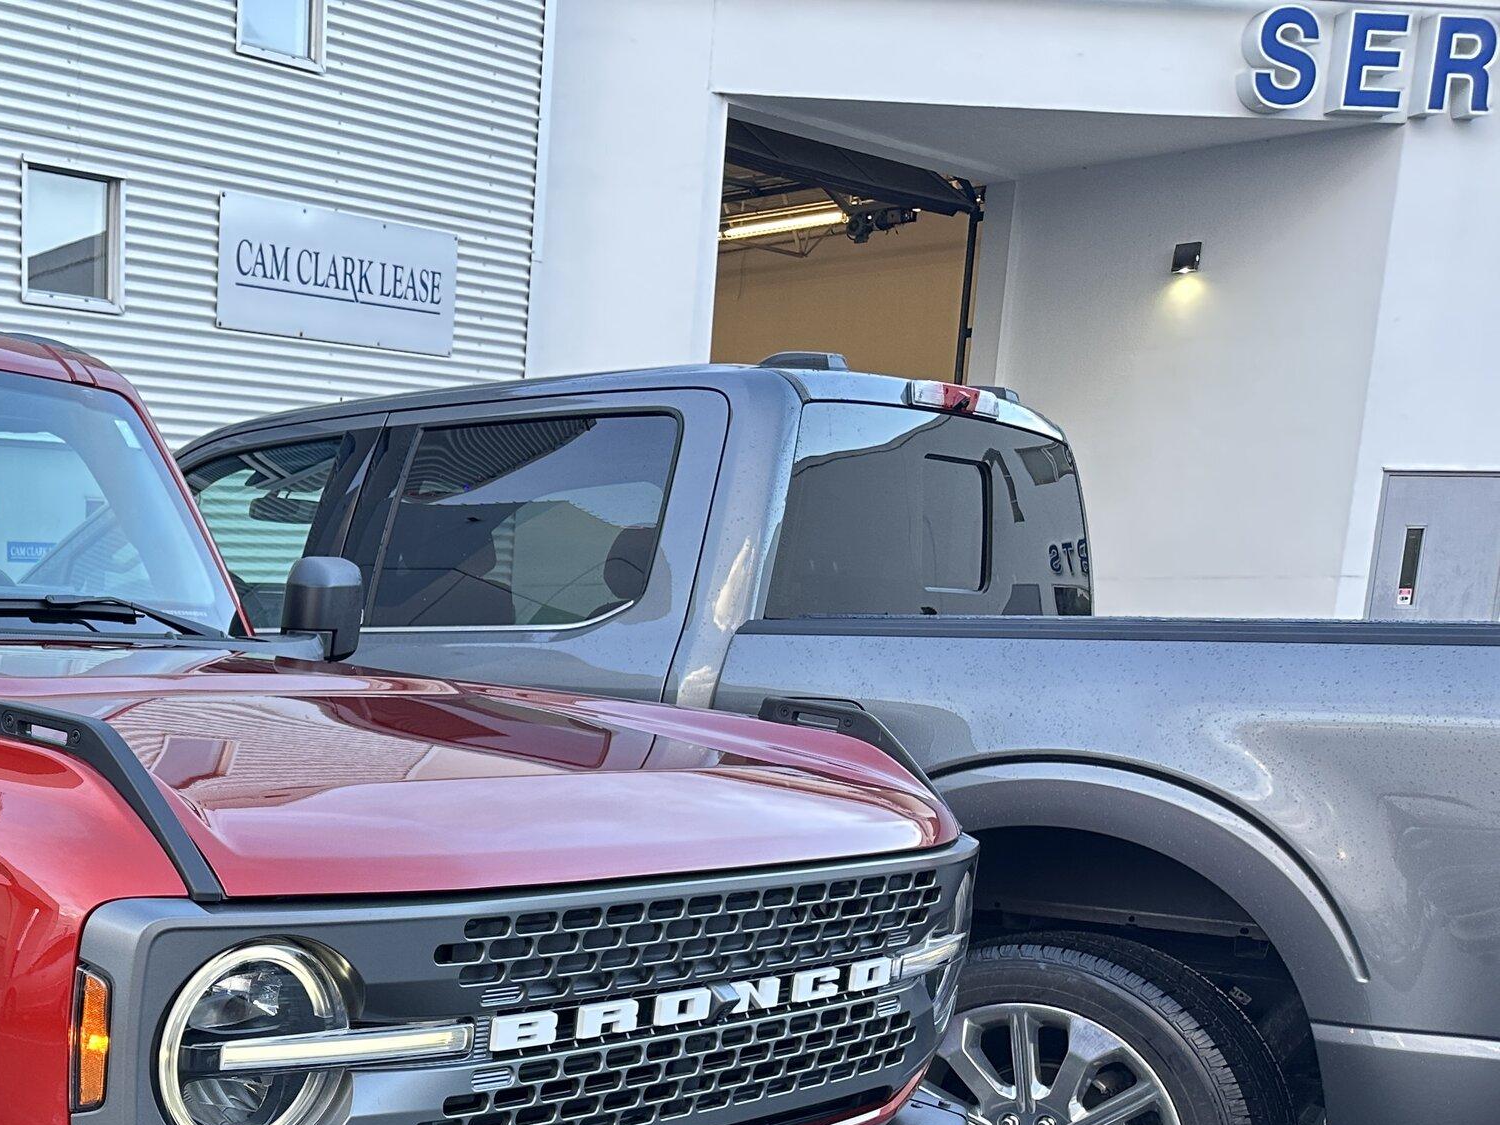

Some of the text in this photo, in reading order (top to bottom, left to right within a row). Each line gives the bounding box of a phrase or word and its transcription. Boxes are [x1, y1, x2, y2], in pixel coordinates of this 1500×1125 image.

[1248, 5, 1500, 115] SER
[236, 239, 442, 305] CAM CLARK LEASE
[489, 956, 892, 1052] BRONCO
